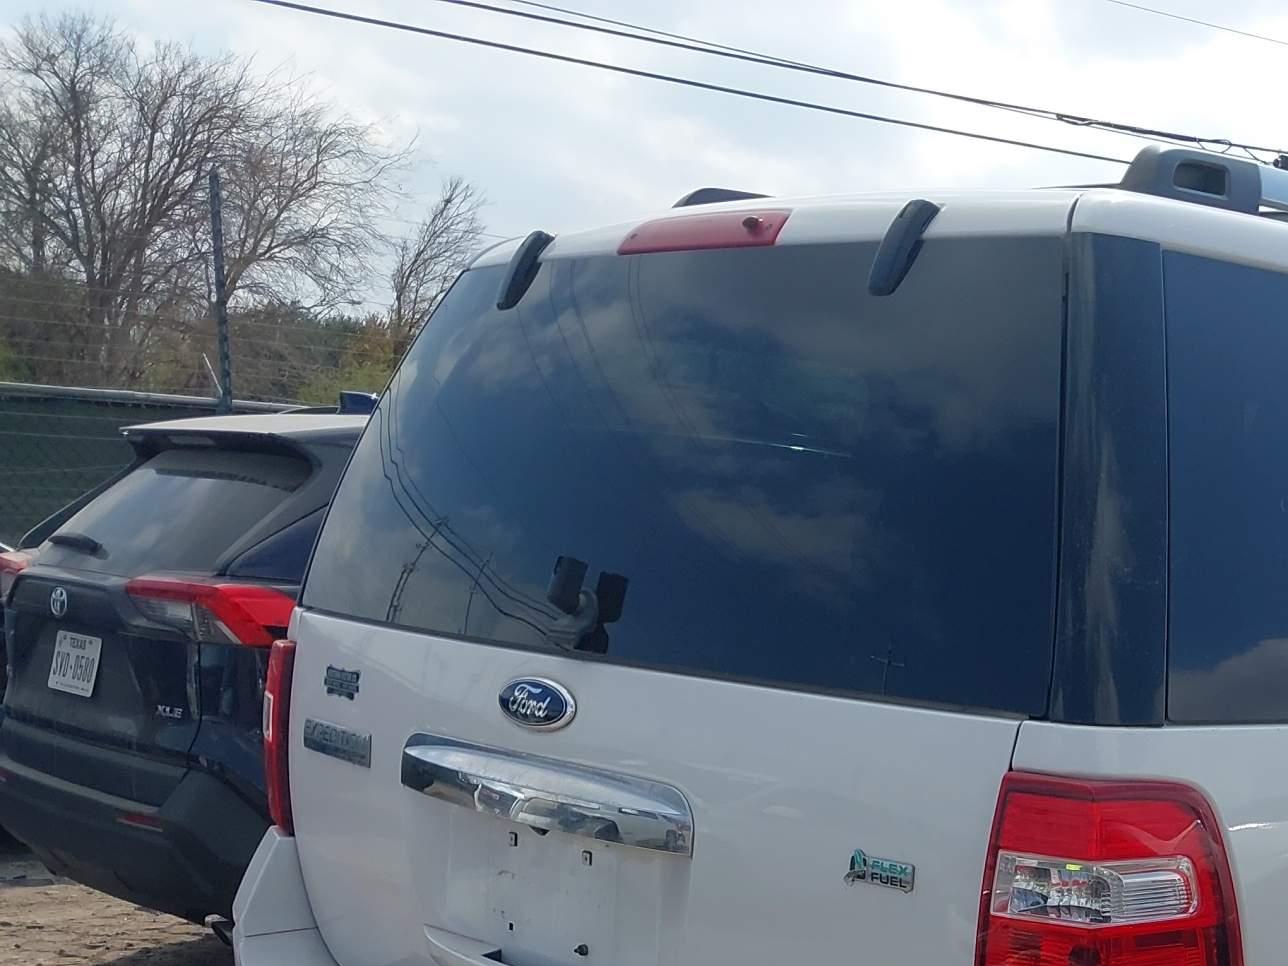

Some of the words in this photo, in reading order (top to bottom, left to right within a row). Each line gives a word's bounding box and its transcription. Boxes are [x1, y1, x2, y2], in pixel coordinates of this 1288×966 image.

[70, 636, 87, 650] TEXAS
[509, 684, 551, 718] Ford
[156, 704, 183, 719] XLE
[870, 860, 909, 877] FLEX
[870, 872, 908, 889] FUEL
